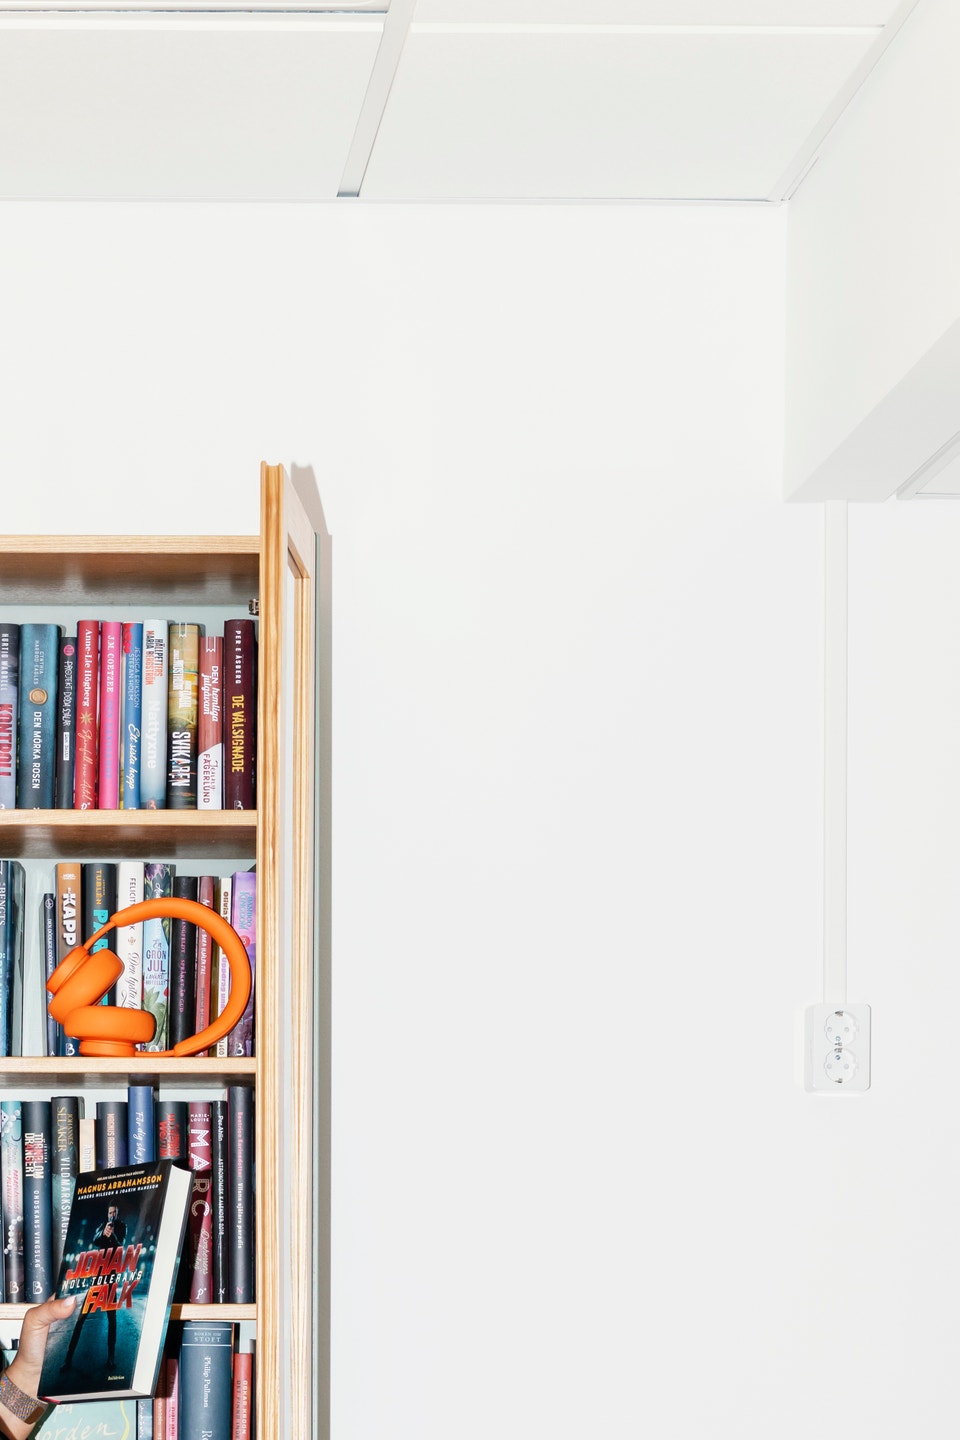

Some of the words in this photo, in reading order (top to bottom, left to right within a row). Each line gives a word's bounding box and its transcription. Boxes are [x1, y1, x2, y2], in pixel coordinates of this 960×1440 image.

[84, 629, 93, 667] Anne-Lie
[106, 653, 114, 694] COETZEE
[211, 665, 220, 684] DEN
[82, 669, 93, 708] Högberg
[231, 694, 244, 709] DE
[32, 711, 42, 728] DEN
[211, 687, 222, 723] hemliga
[32, 730, 45, 760] MÖRKA
[128, 723, 140, 742] Ett
[231, 710, 246, 773] VÄLSIGNADE
[128, 743, 138, 765] sista
[169, 731, 192, 788] SVIKAREN
[32, 762, 41, 789] ROSEN
[126, 766, 138, 791] hopp
[202, 753, 211, 804] FAGERLUND
[77, 1181, 107, 1195] MAGNUS
[107, 1174, 162, 1190] ABRAHAMSSON
[65, 1243, 143, 1280] JOHAN
[81, 1279, 140, 1314] FALK
[200, 1356, 212, 1378] Philip
[202, 1379, 211, 1408] Pullman
